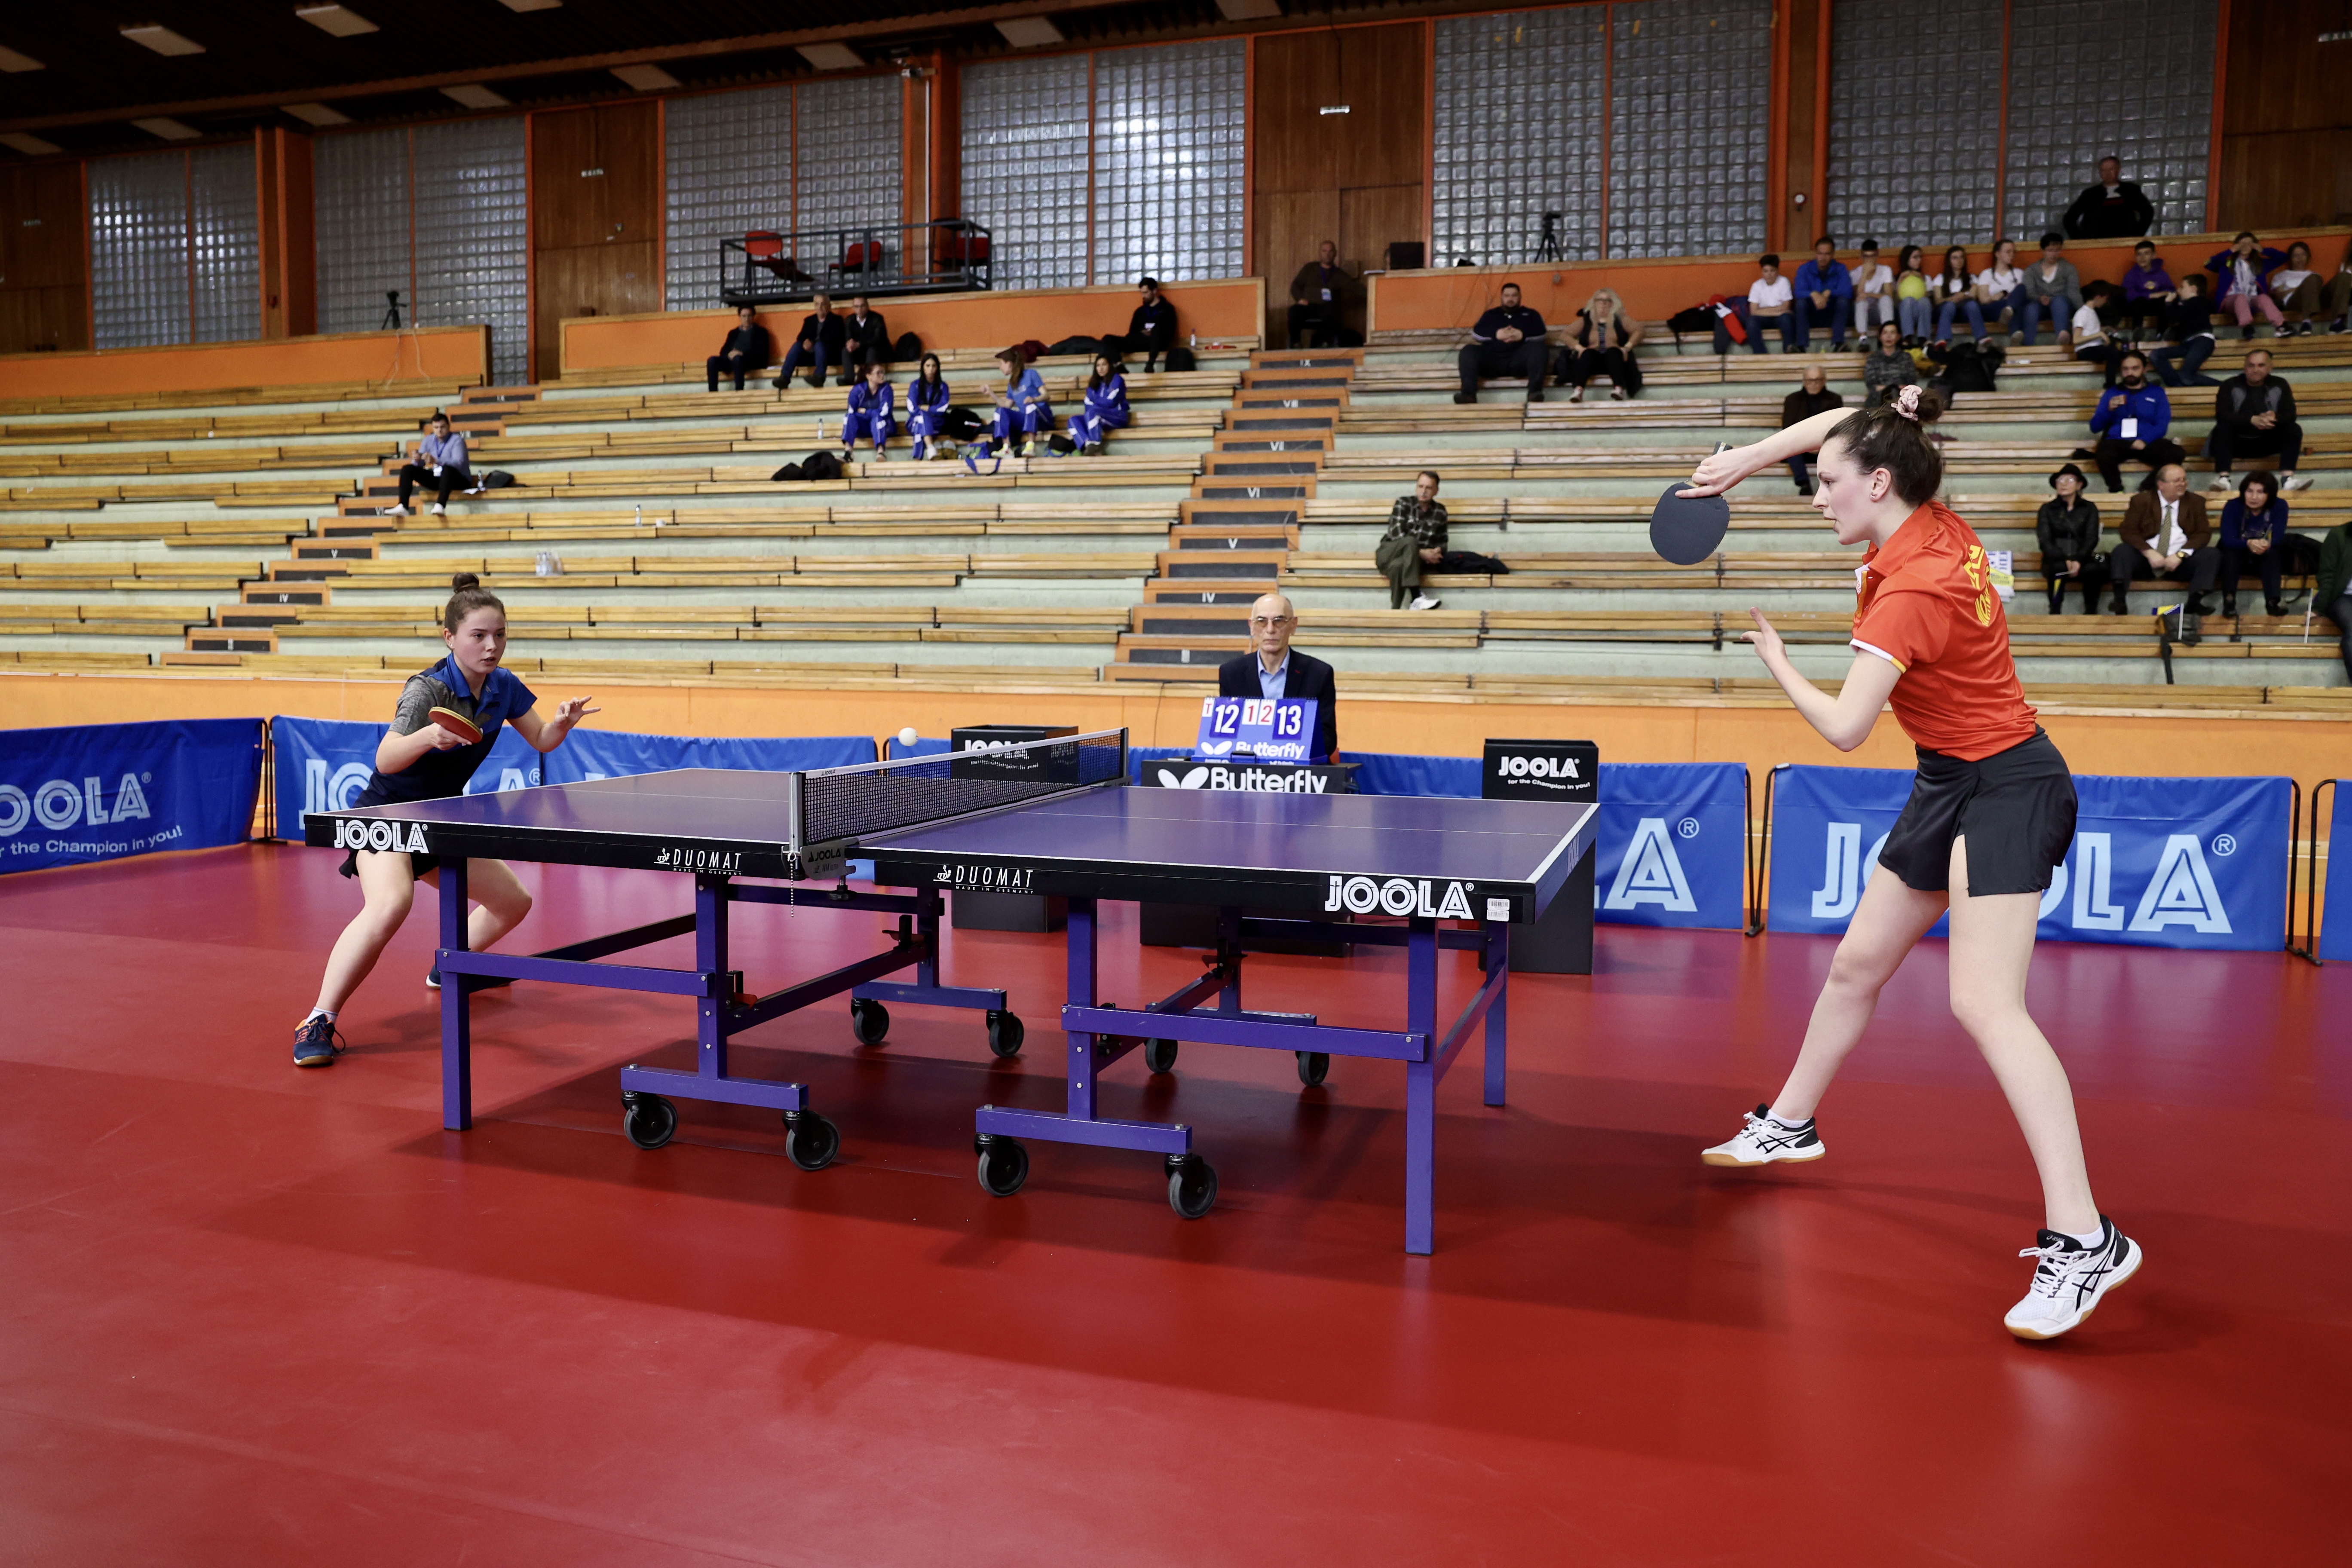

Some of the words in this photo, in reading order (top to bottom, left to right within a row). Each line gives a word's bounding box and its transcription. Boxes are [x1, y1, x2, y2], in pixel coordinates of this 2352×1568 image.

[1247, 487, 1260, 498] VI
[1228, 538, 1238, 549] V
[331, 549, 338, 558] V
[279, 593, 289, 603] IV
[1202, 592, 1216, 603] IV
[1206, 704, 1212, 714] T
[1215, 704, 1239, 734] 12
[1248, 705, 1254, 722] 1
[1261, 705, 1272, 722] 2
[1277, 705, 1302, 735] 13
[1235, 741, 1305, 760] Butterfly
[1211, 767, 1328, 793] Butterfly
[1532, 779, 1566, 789] Champion
[1575, 782, 1590, 790] you!
[10, 842, 40, 855] the
[46, 840, 128, 855] Champion
[132, 839, 144, 850] in
[148, 825, 183, 848] you!
[673, 849, 741, 870] DUOMAT
[956, 866, 1033, 887] DUOMAT
